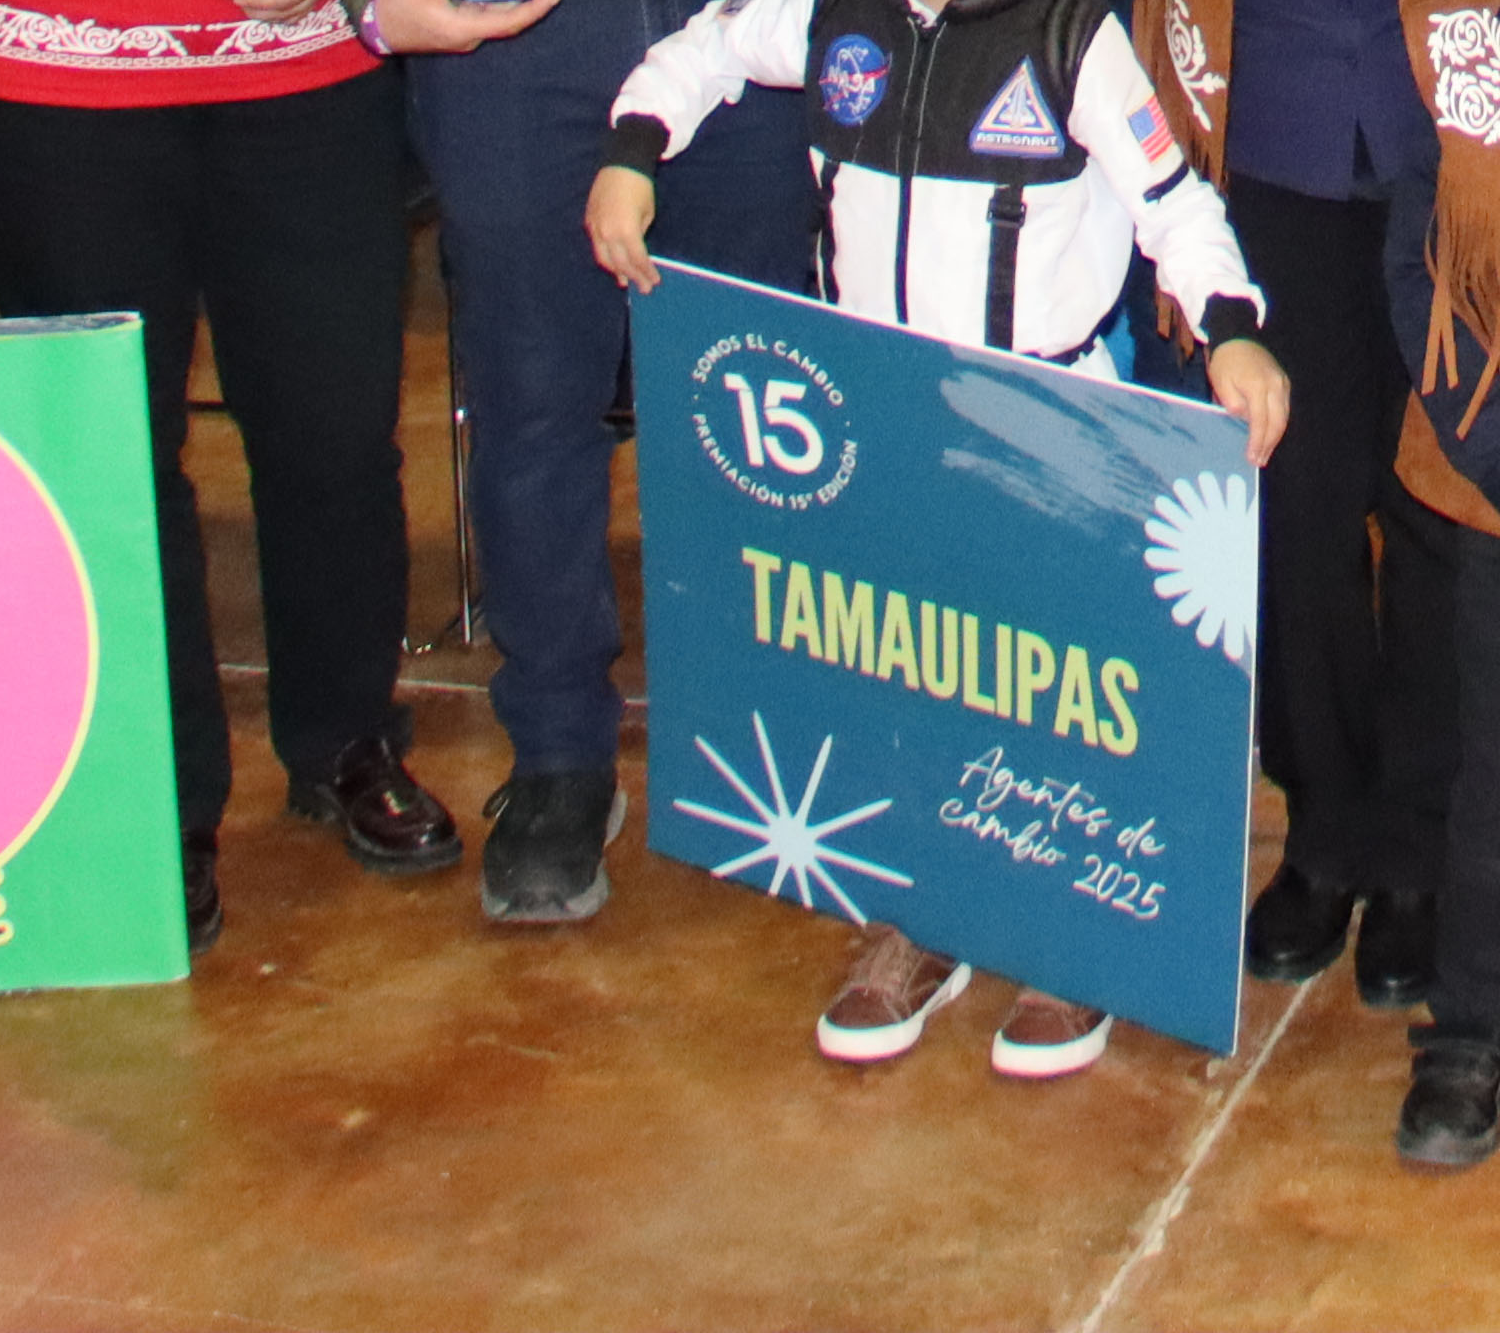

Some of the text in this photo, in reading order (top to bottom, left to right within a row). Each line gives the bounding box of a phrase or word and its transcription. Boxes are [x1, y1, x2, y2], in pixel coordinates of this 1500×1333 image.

[828, 64, 876, 98] NASA
[975, 132, 1058, 147] ASTRONAUT
[692, 333, 844, 407] SOMOS EL CAMBIO
[692, 413, 785, 509] PREMIACIÓN
[816, 439, 858, 505] EDICIÓN
[723, 372, 824, 475] 15
[740, 545, 1140, 758] TAMAULIPAS
[959, 745, 1166, 859] Agentes de
[1072, 853, 1166, 920] 2025
